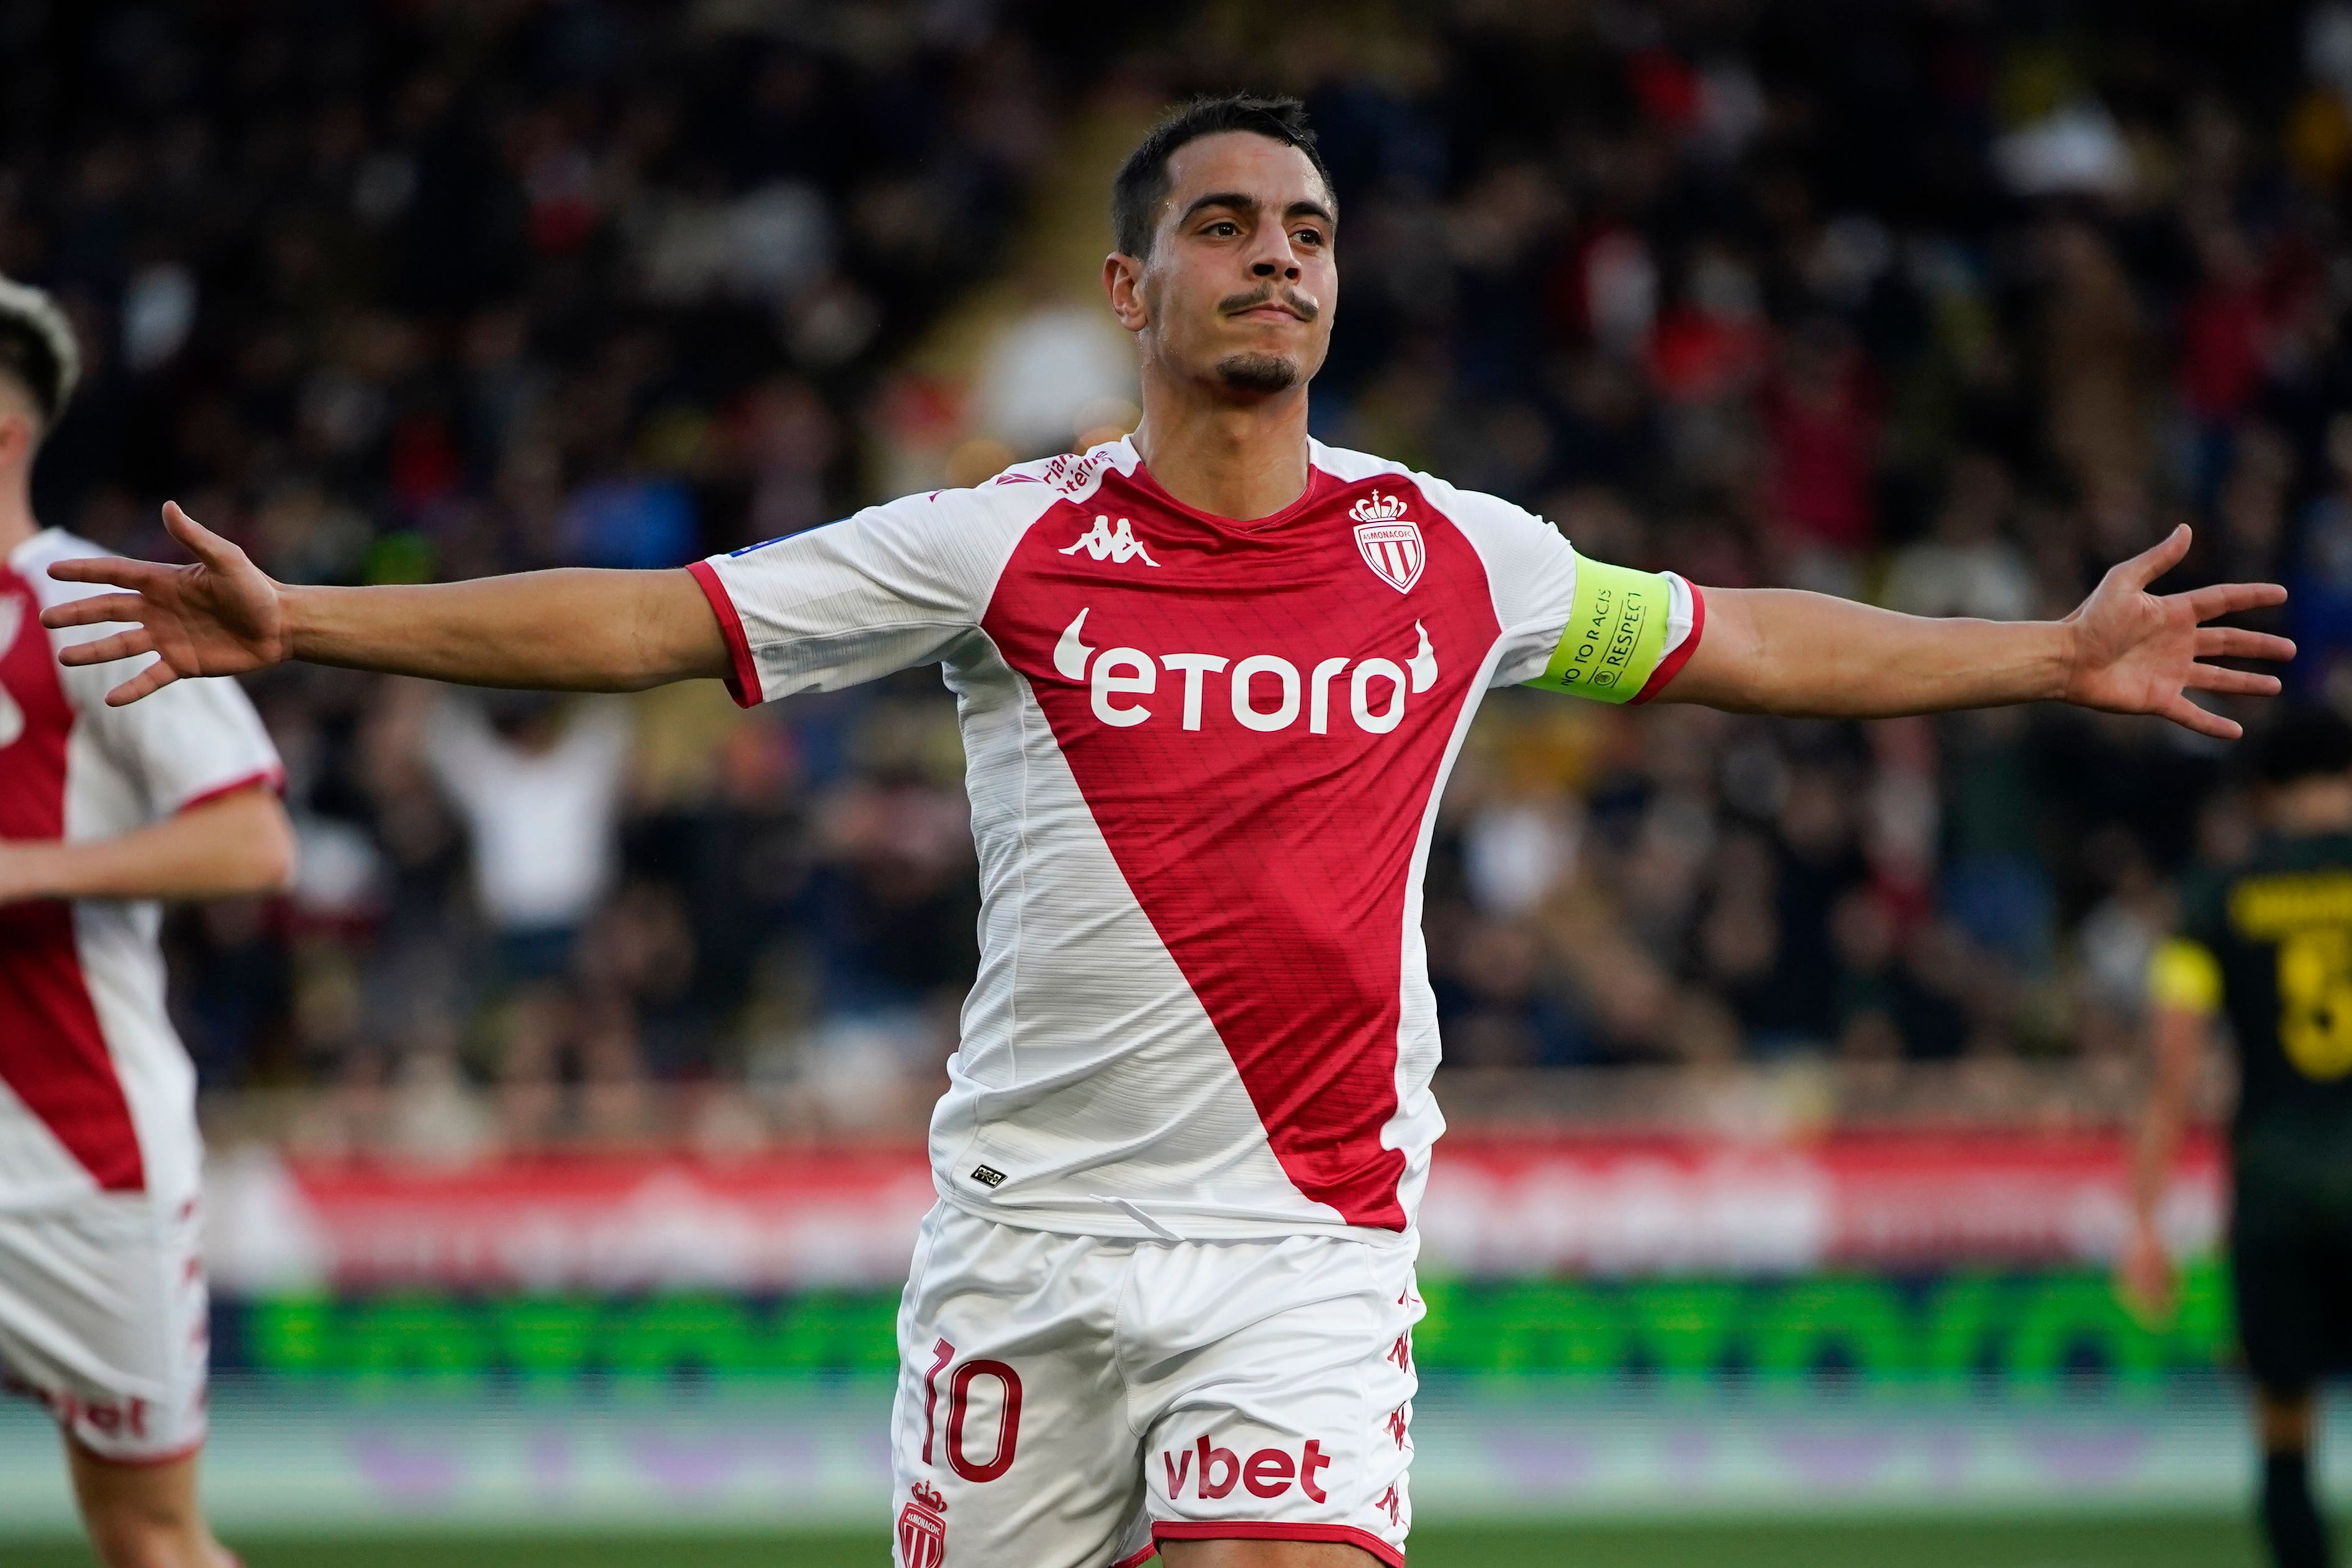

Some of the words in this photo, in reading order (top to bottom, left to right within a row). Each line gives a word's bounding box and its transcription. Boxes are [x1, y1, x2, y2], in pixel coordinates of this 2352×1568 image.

[1561, 668, 1581, 686] NO
[1574, 644, 1594, 663] TO
[922, 1337, 1022, 1483] 10
[1164, 1434, 1331, 1503] vbet
